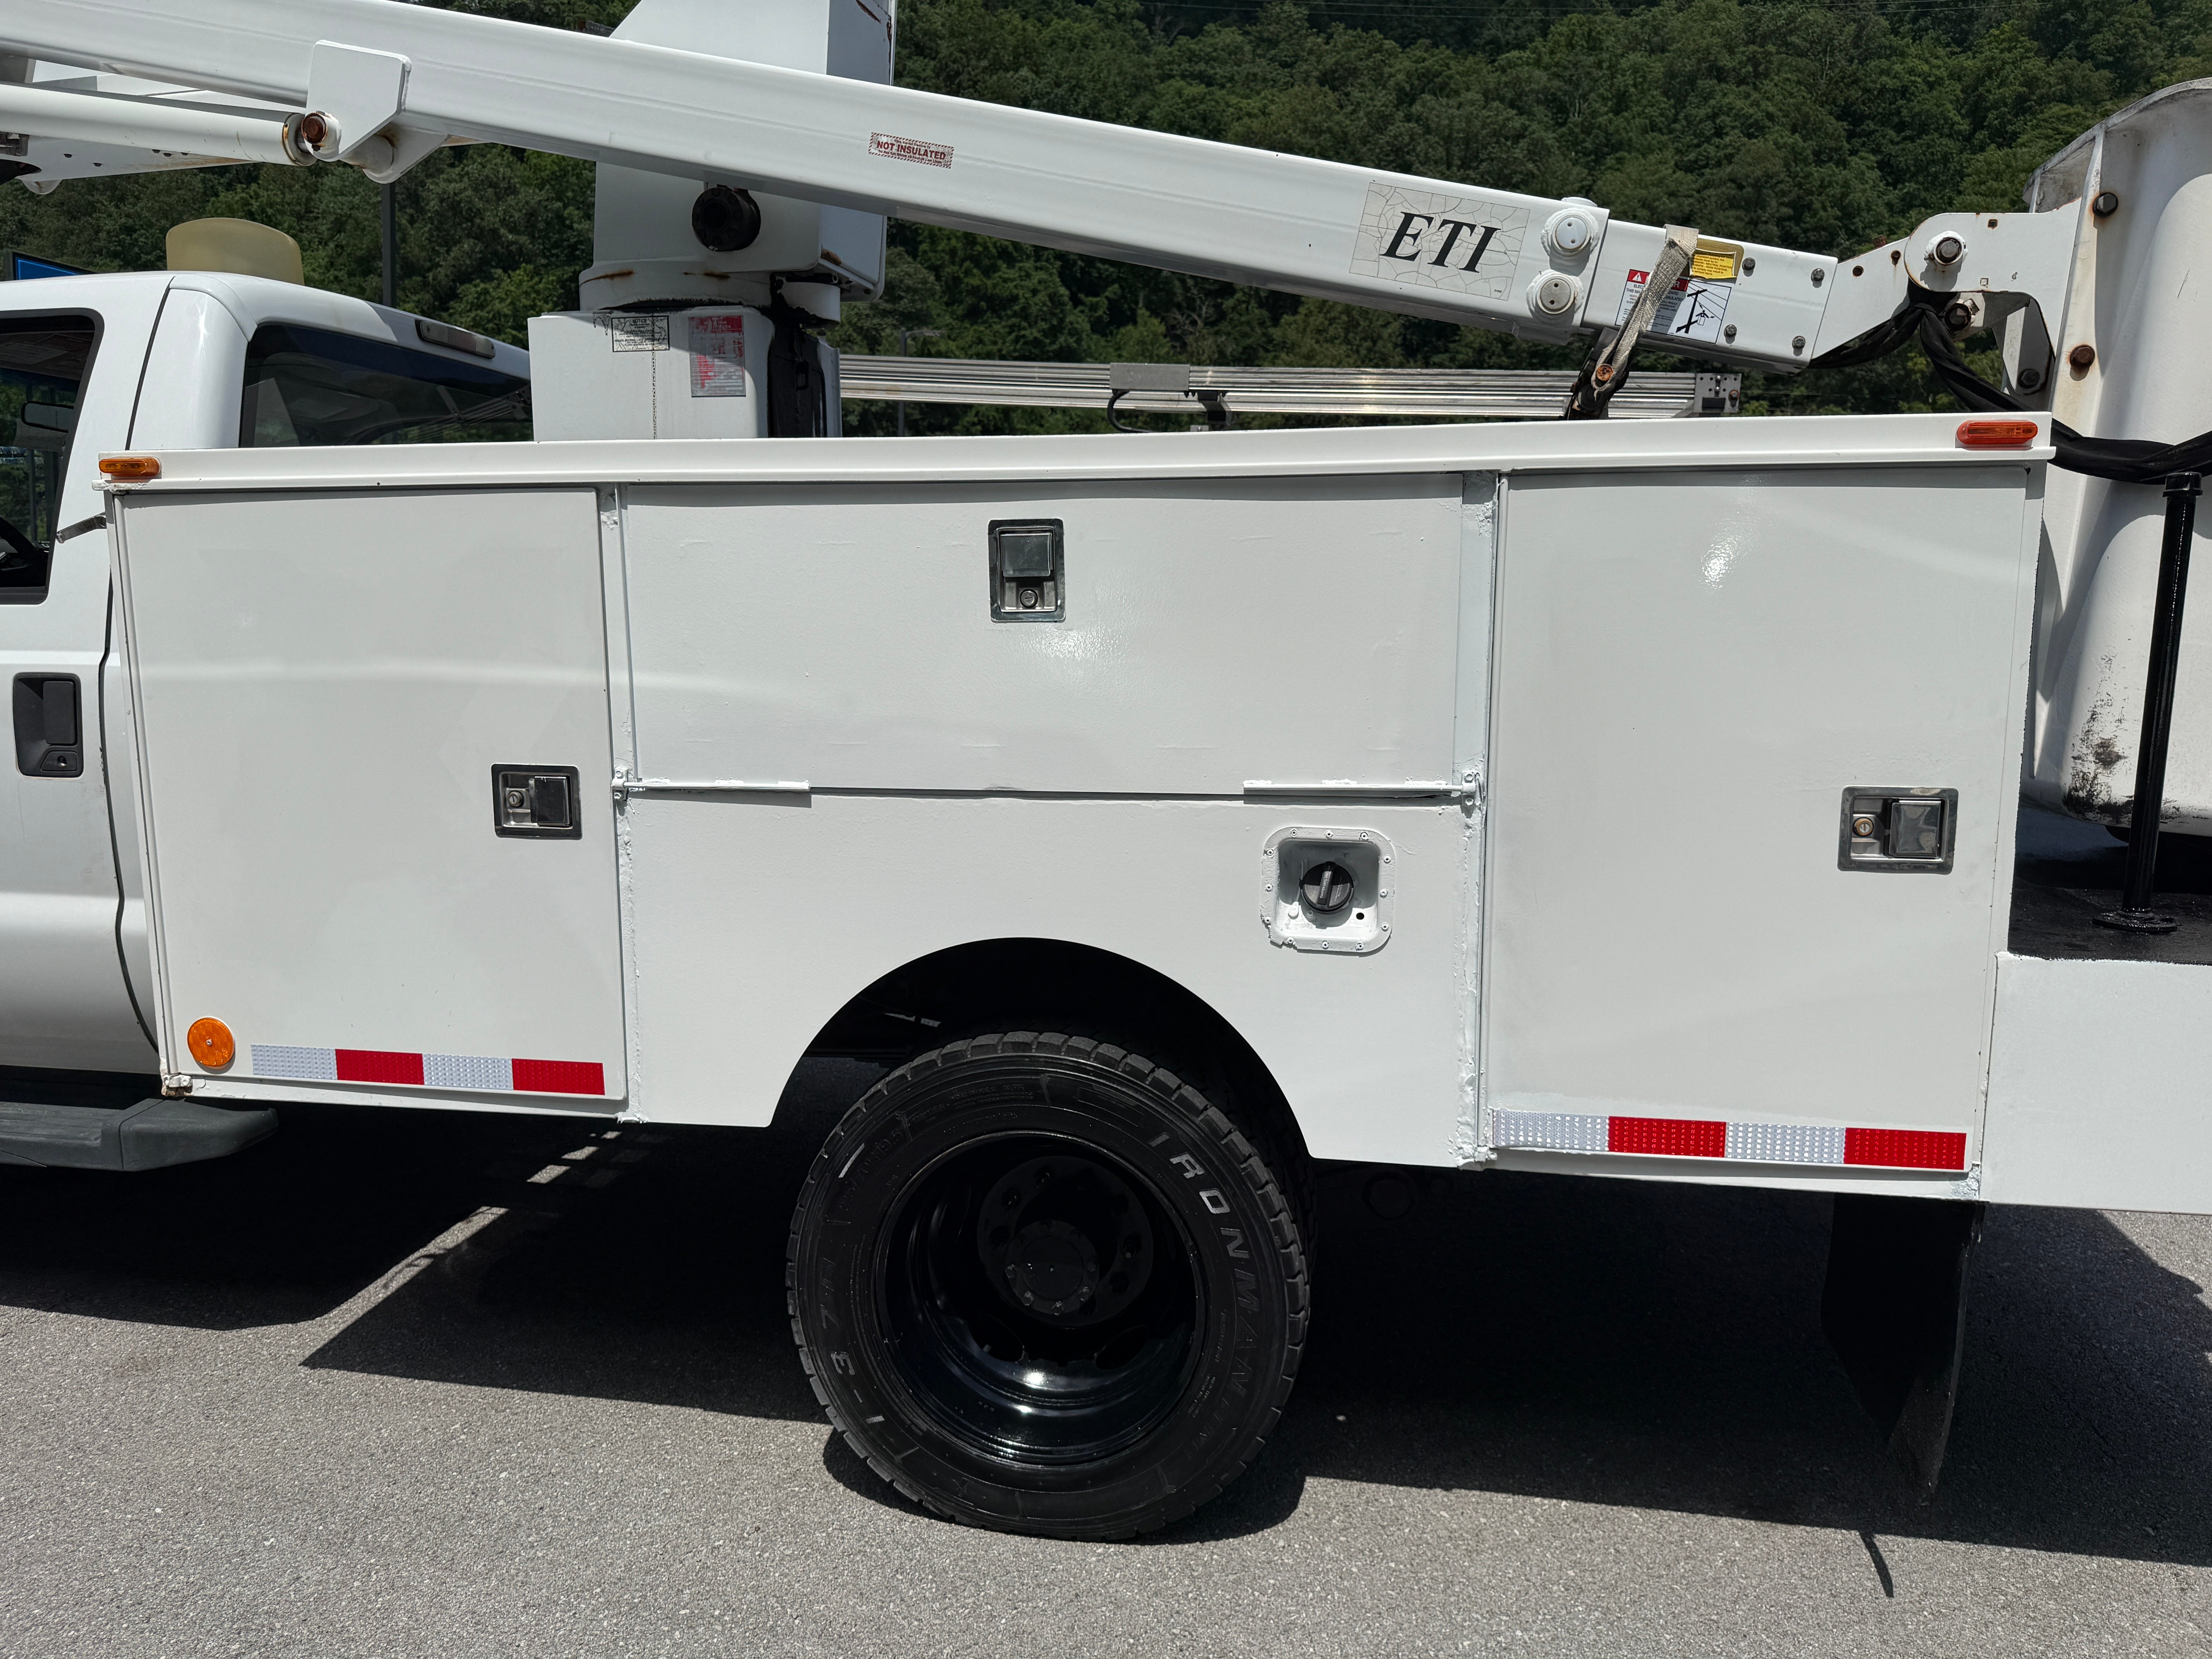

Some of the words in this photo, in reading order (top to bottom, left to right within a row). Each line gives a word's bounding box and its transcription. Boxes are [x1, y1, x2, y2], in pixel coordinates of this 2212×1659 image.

[876, 141, 895, 150] NOT
[897, 144, 946, 160] INSULATED
[1379, 211, 1501, 273] ETI
[1147, 1132, 1261, 1397] IRONMAN
